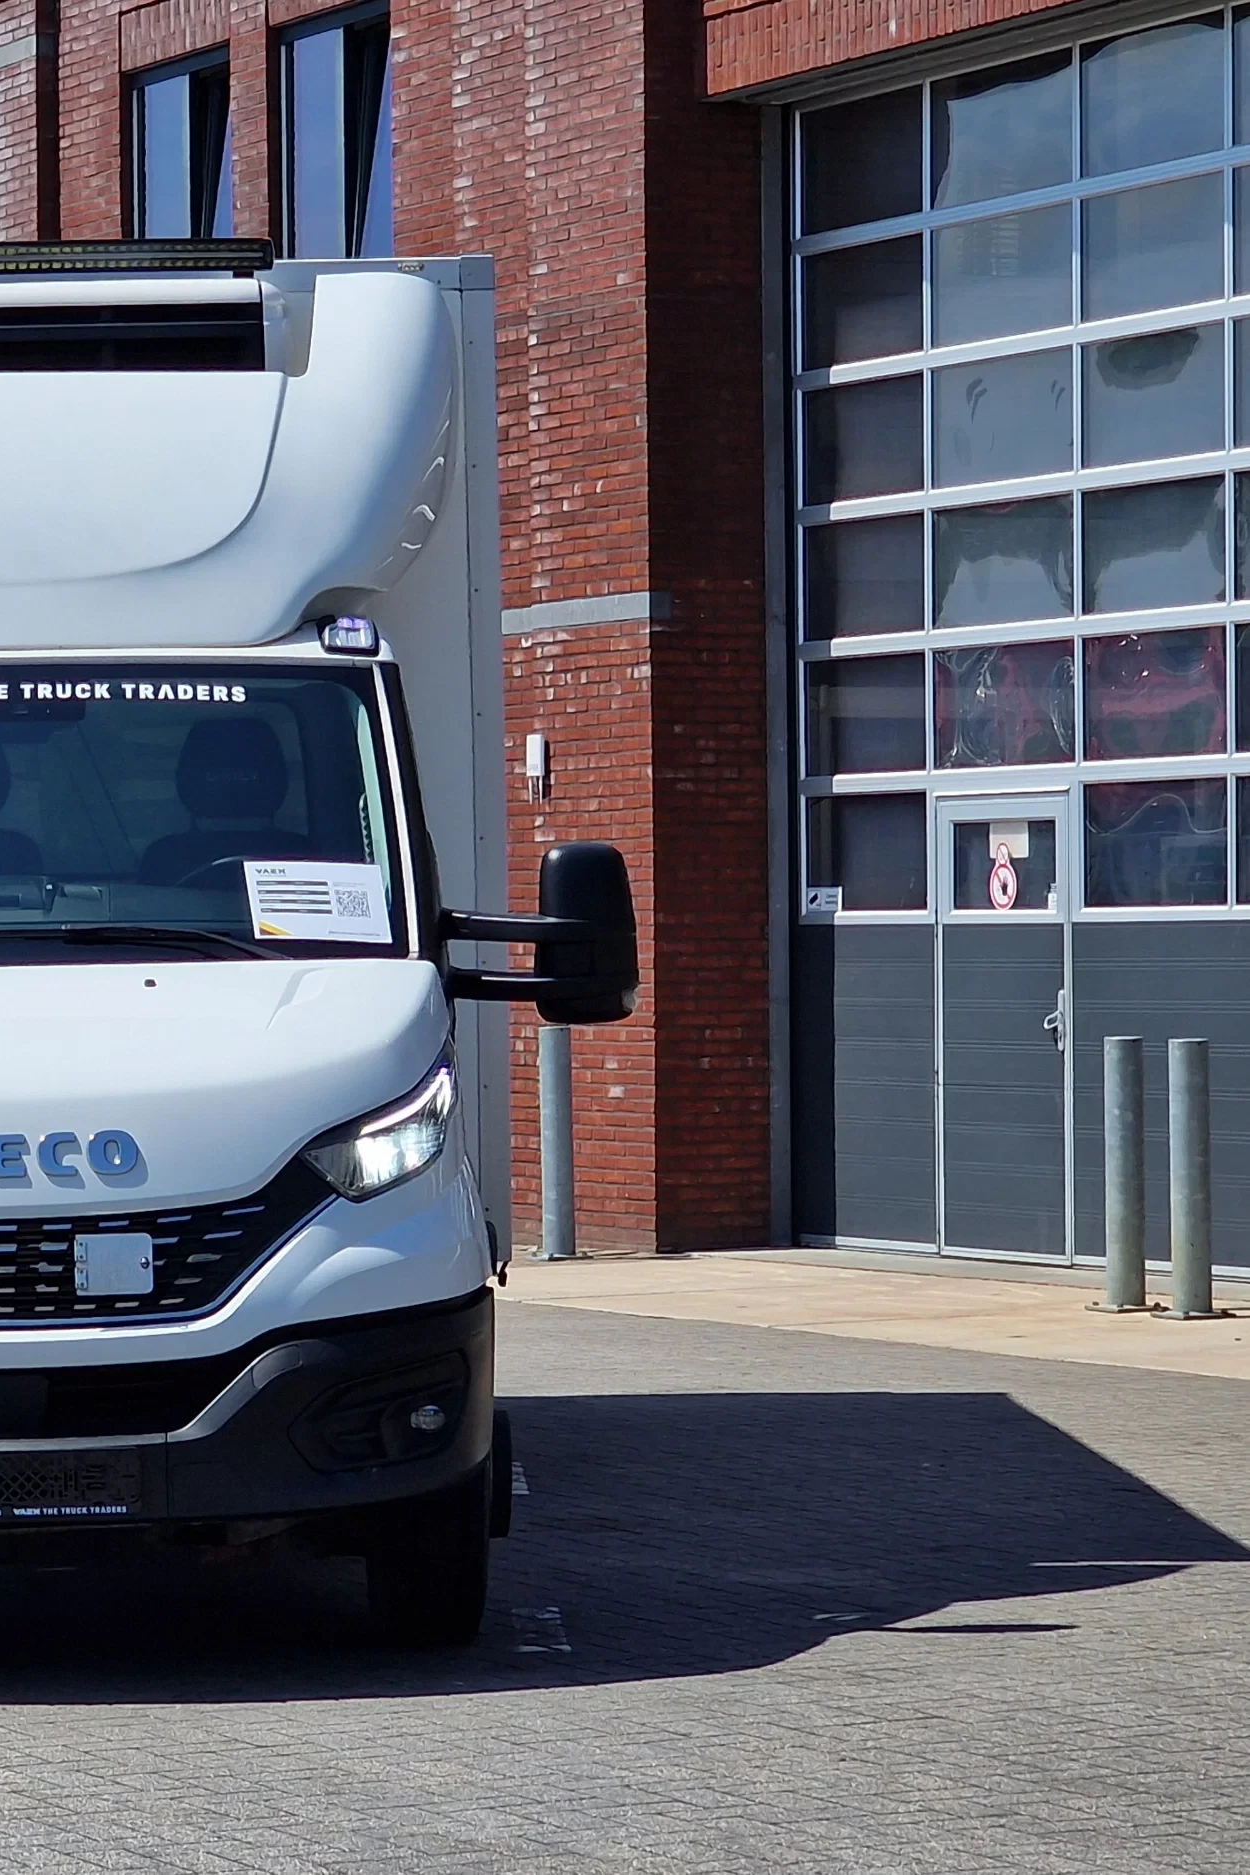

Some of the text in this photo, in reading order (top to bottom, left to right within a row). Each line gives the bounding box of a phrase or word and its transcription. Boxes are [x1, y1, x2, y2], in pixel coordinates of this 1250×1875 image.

[20, 683, 111, 700] TRUCK
[121, 683, 247, 702] TRADERS
[43, 1507, 58, 1515] THE
[61, 1507, 88, 1515] TRUCK
[90, 1506, 127, 1514] TRADERS
